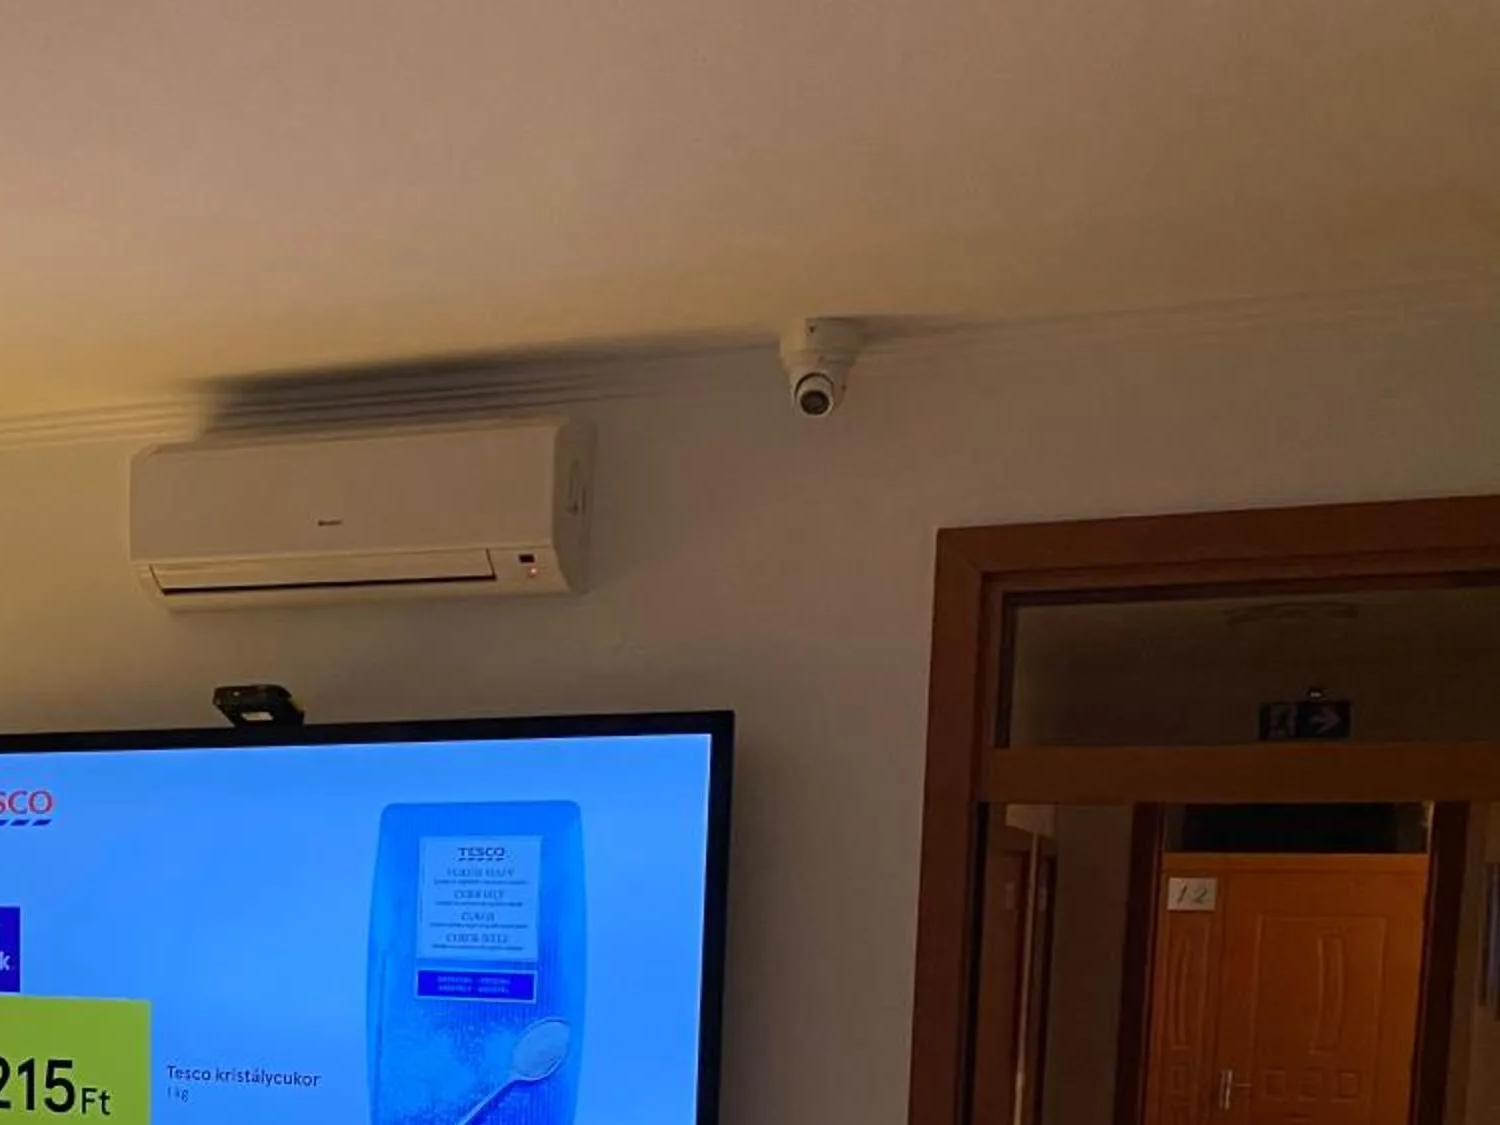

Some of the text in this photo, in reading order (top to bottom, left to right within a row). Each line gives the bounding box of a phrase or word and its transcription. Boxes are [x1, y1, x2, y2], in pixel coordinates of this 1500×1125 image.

[458, 847, 505, 857] TESCO
[167, 1065, 321, 1088] Tesco kristálycukor
